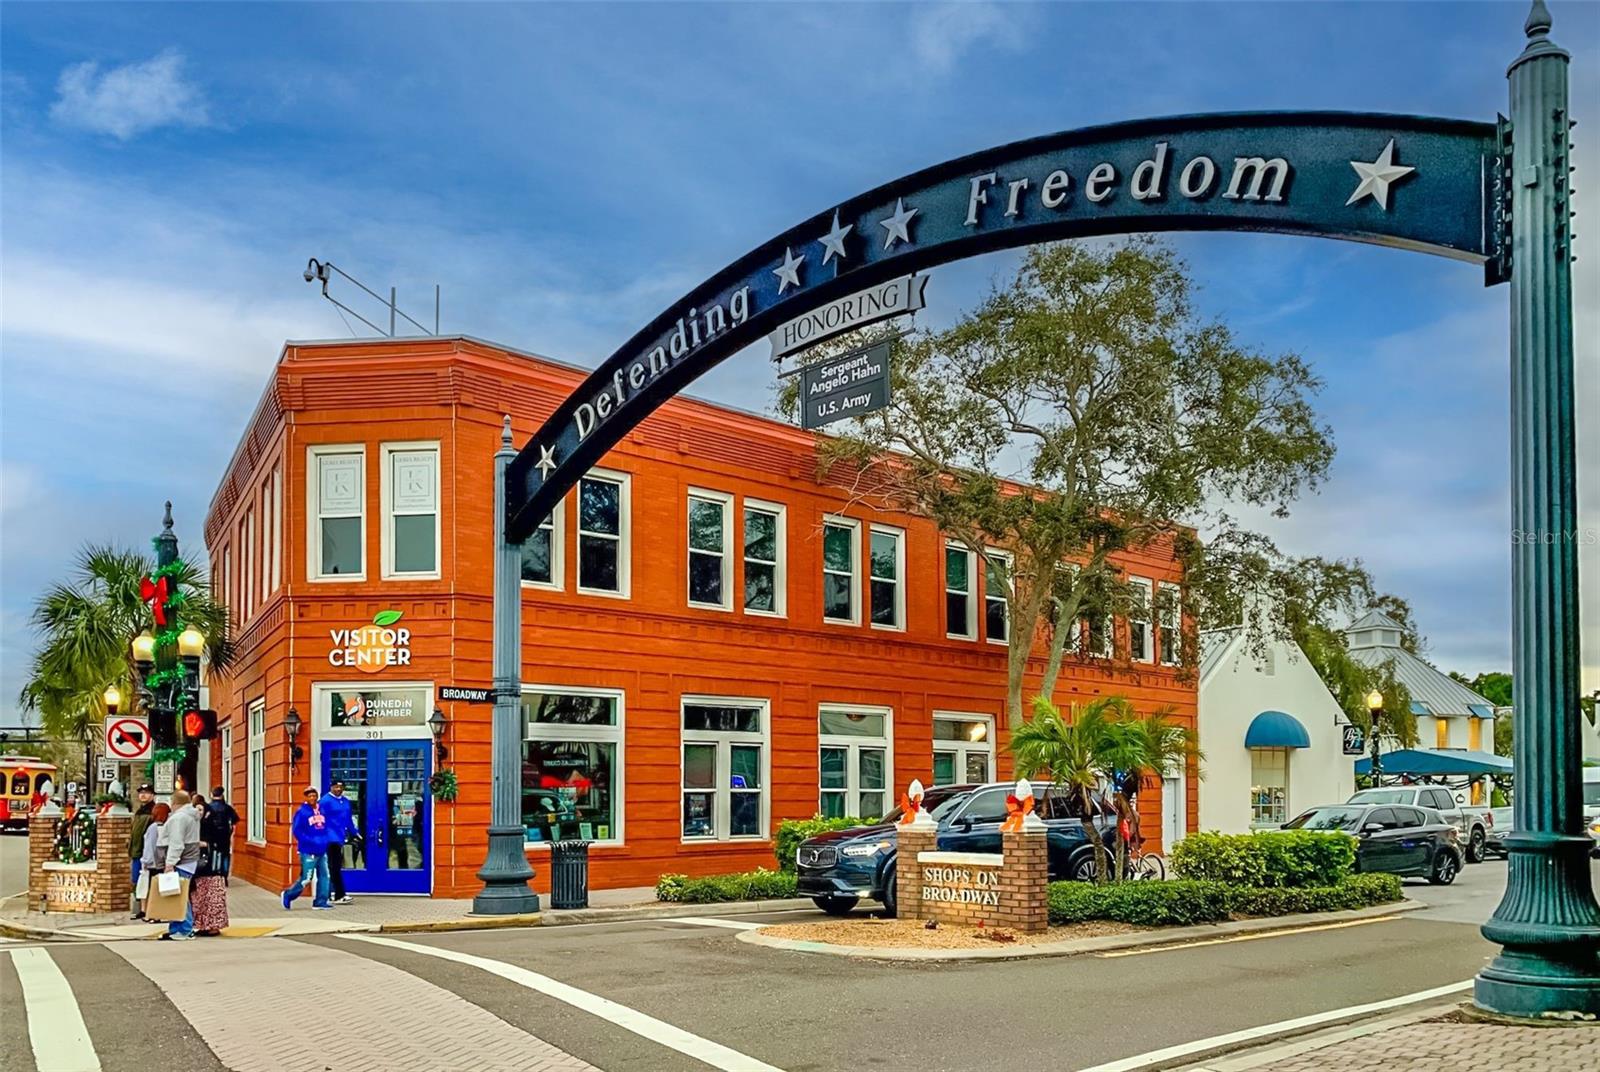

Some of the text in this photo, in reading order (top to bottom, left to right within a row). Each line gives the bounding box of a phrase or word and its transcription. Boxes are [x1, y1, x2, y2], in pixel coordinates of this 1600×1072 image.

[573, 142, 1289, 441] Defending Freedom
[784, 284, 899, 347] HONORING
[821, 354, 868, 379] Sergeant
[810, 364, 881, 395] Angelo Hahn
[818, 393, 872, 417] U.S. Army
[330, 628, 411, 647] VISITOR
[329, 648, 411, 667] CENTER
[442, 688, 488, 701] BROADWAY
[366, 709, 412, 718] CHAMBER
[366, 731, 384, 739] 301
[101, 769, 115, 779] 15
[924, 867, 1001, 886] SHOPS ON
[922, 886, 1000, 905] BROADWAY
